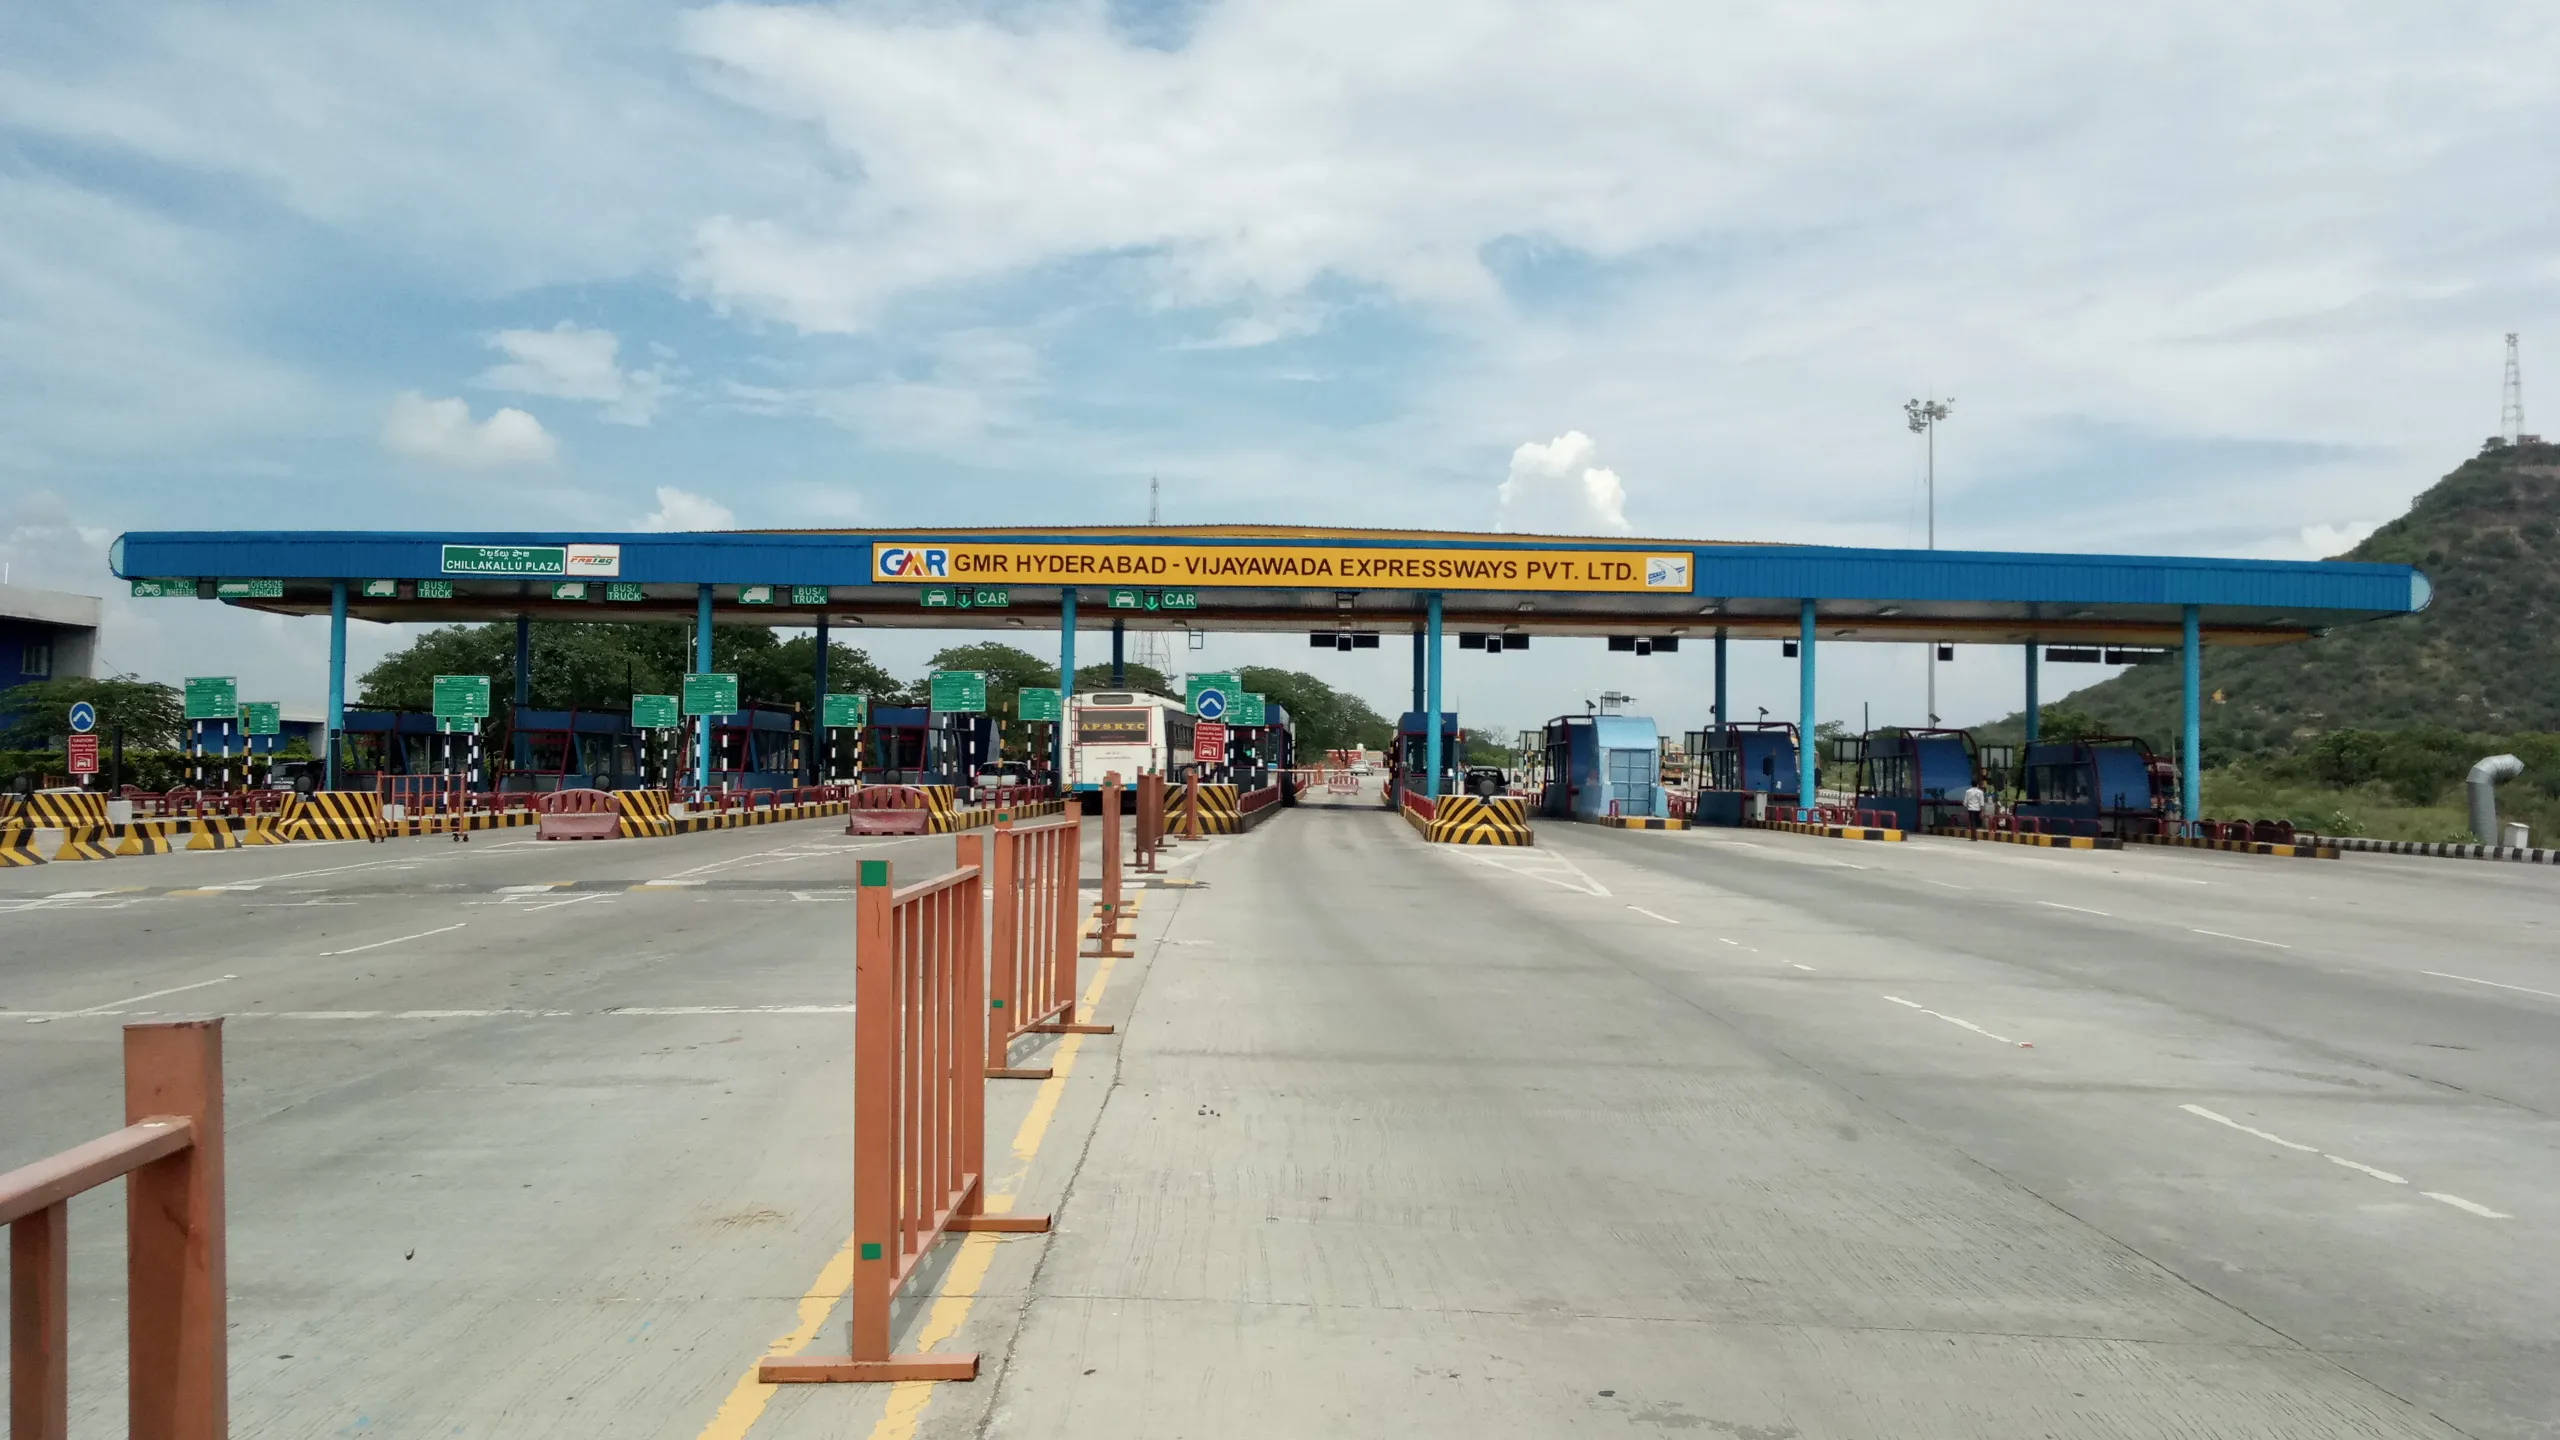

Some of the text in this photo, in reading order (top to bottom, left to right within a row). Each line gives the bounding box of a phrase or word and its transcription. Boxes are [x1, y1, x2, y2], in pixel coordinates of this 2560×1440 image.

[446, 560, 561, 572] CHILLAKALLU PLAZA
[880, 549, 947, 577] GMR
[954, 554, 1008, 573] GMR
[1016, 555, 1167, 574] HYDERABAD
[1185, 556, 1333, 577] VIJAYAWADA
[1340, 558, 1517, 579] EXPRESSWAYS
[1527, 561, 1579, 580] PVT.
[1588, 562, 1638, 581] LTD.
[174, 580, 190, 588] TWO
[251, 580, 284, 589] OVERSIZE
[424, 581, 447, 590] BUS/
[613, 584, 637, 592] BUS/
[251, 588, 283, 597] VEHICLES
[420, 589, 451, 598] TRUCK
[799, 587, 821, 596] BUS/
[608, 592, 640, 601] TRUCK
[794, 595, 826, 604] TRUCK
[977, 591, 1007, 605] CAR
[1165, 593, 1195, 606] CAR
